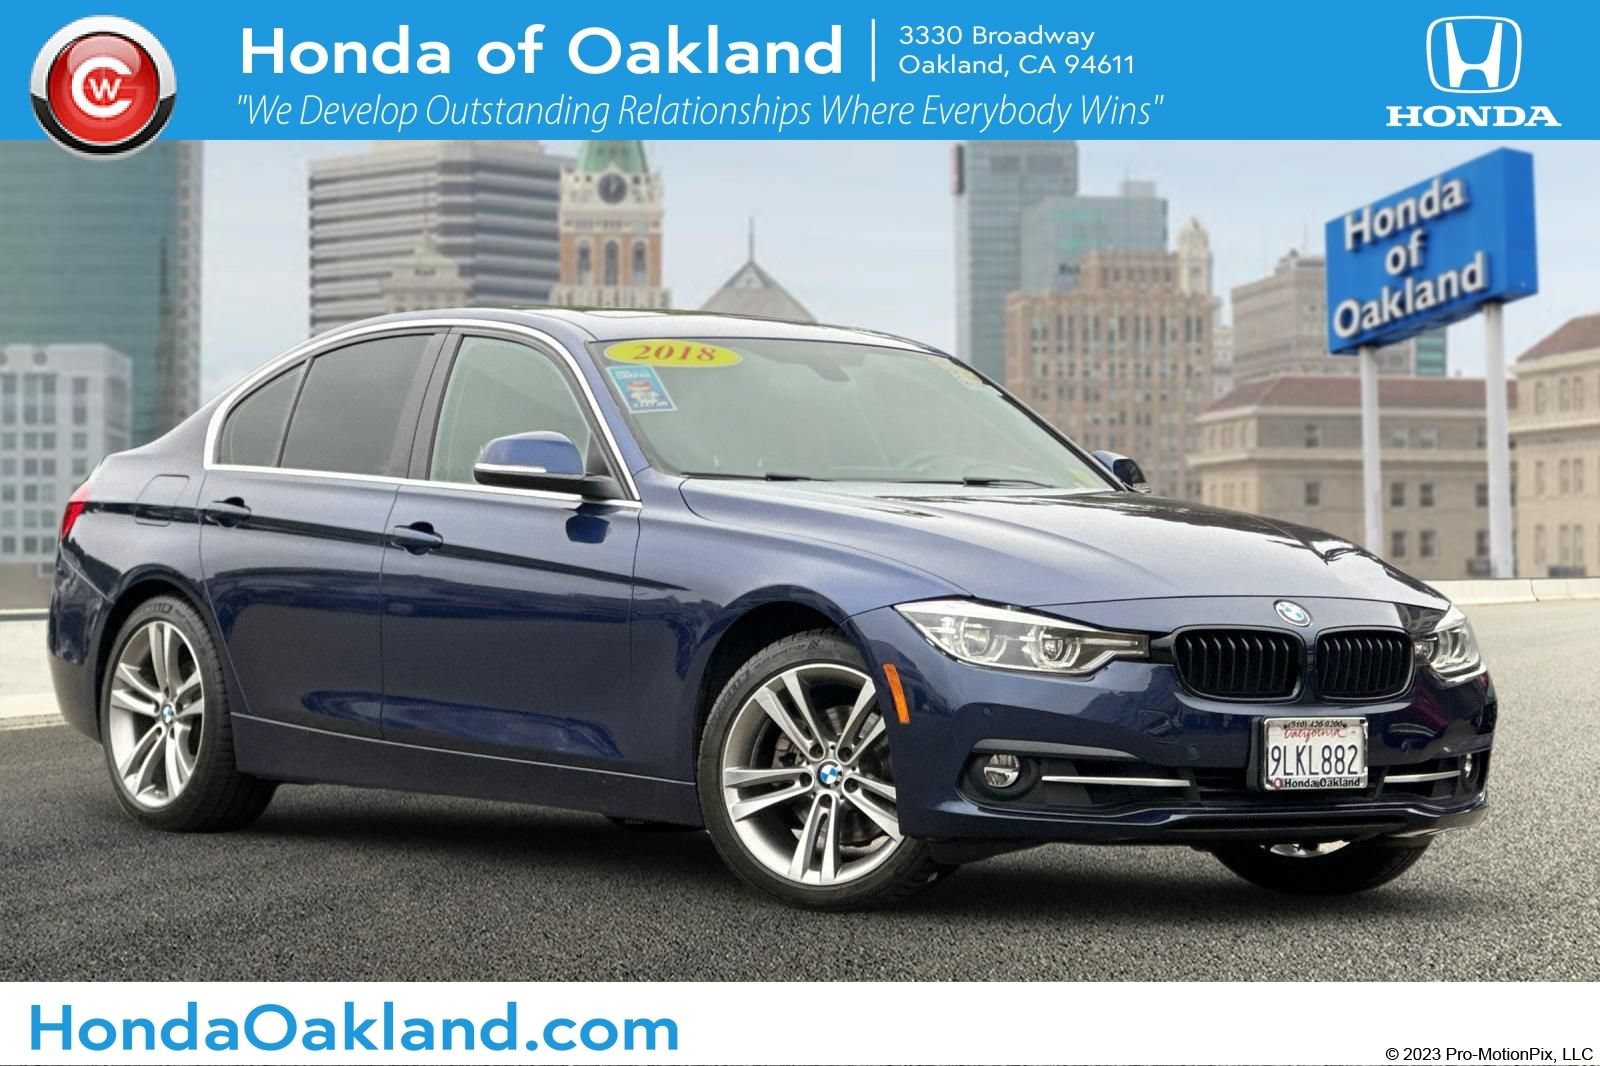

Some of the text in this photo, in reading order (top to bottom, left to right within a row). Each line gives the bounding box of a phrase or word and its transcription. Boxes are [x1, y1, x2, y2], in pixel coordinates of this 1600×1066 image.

[1343, 175, 1468, 252] Honda
[1385, 229, 1426, 276] of
[1333, 250, 1488, 339] Oakland
[631, 344, 717, 361] 2018
[1270, 744, 1358, 776] 9LKL882
[1284, 778, 1315, 788] Honda
[1319, 777, 1360, 787] Oakland
